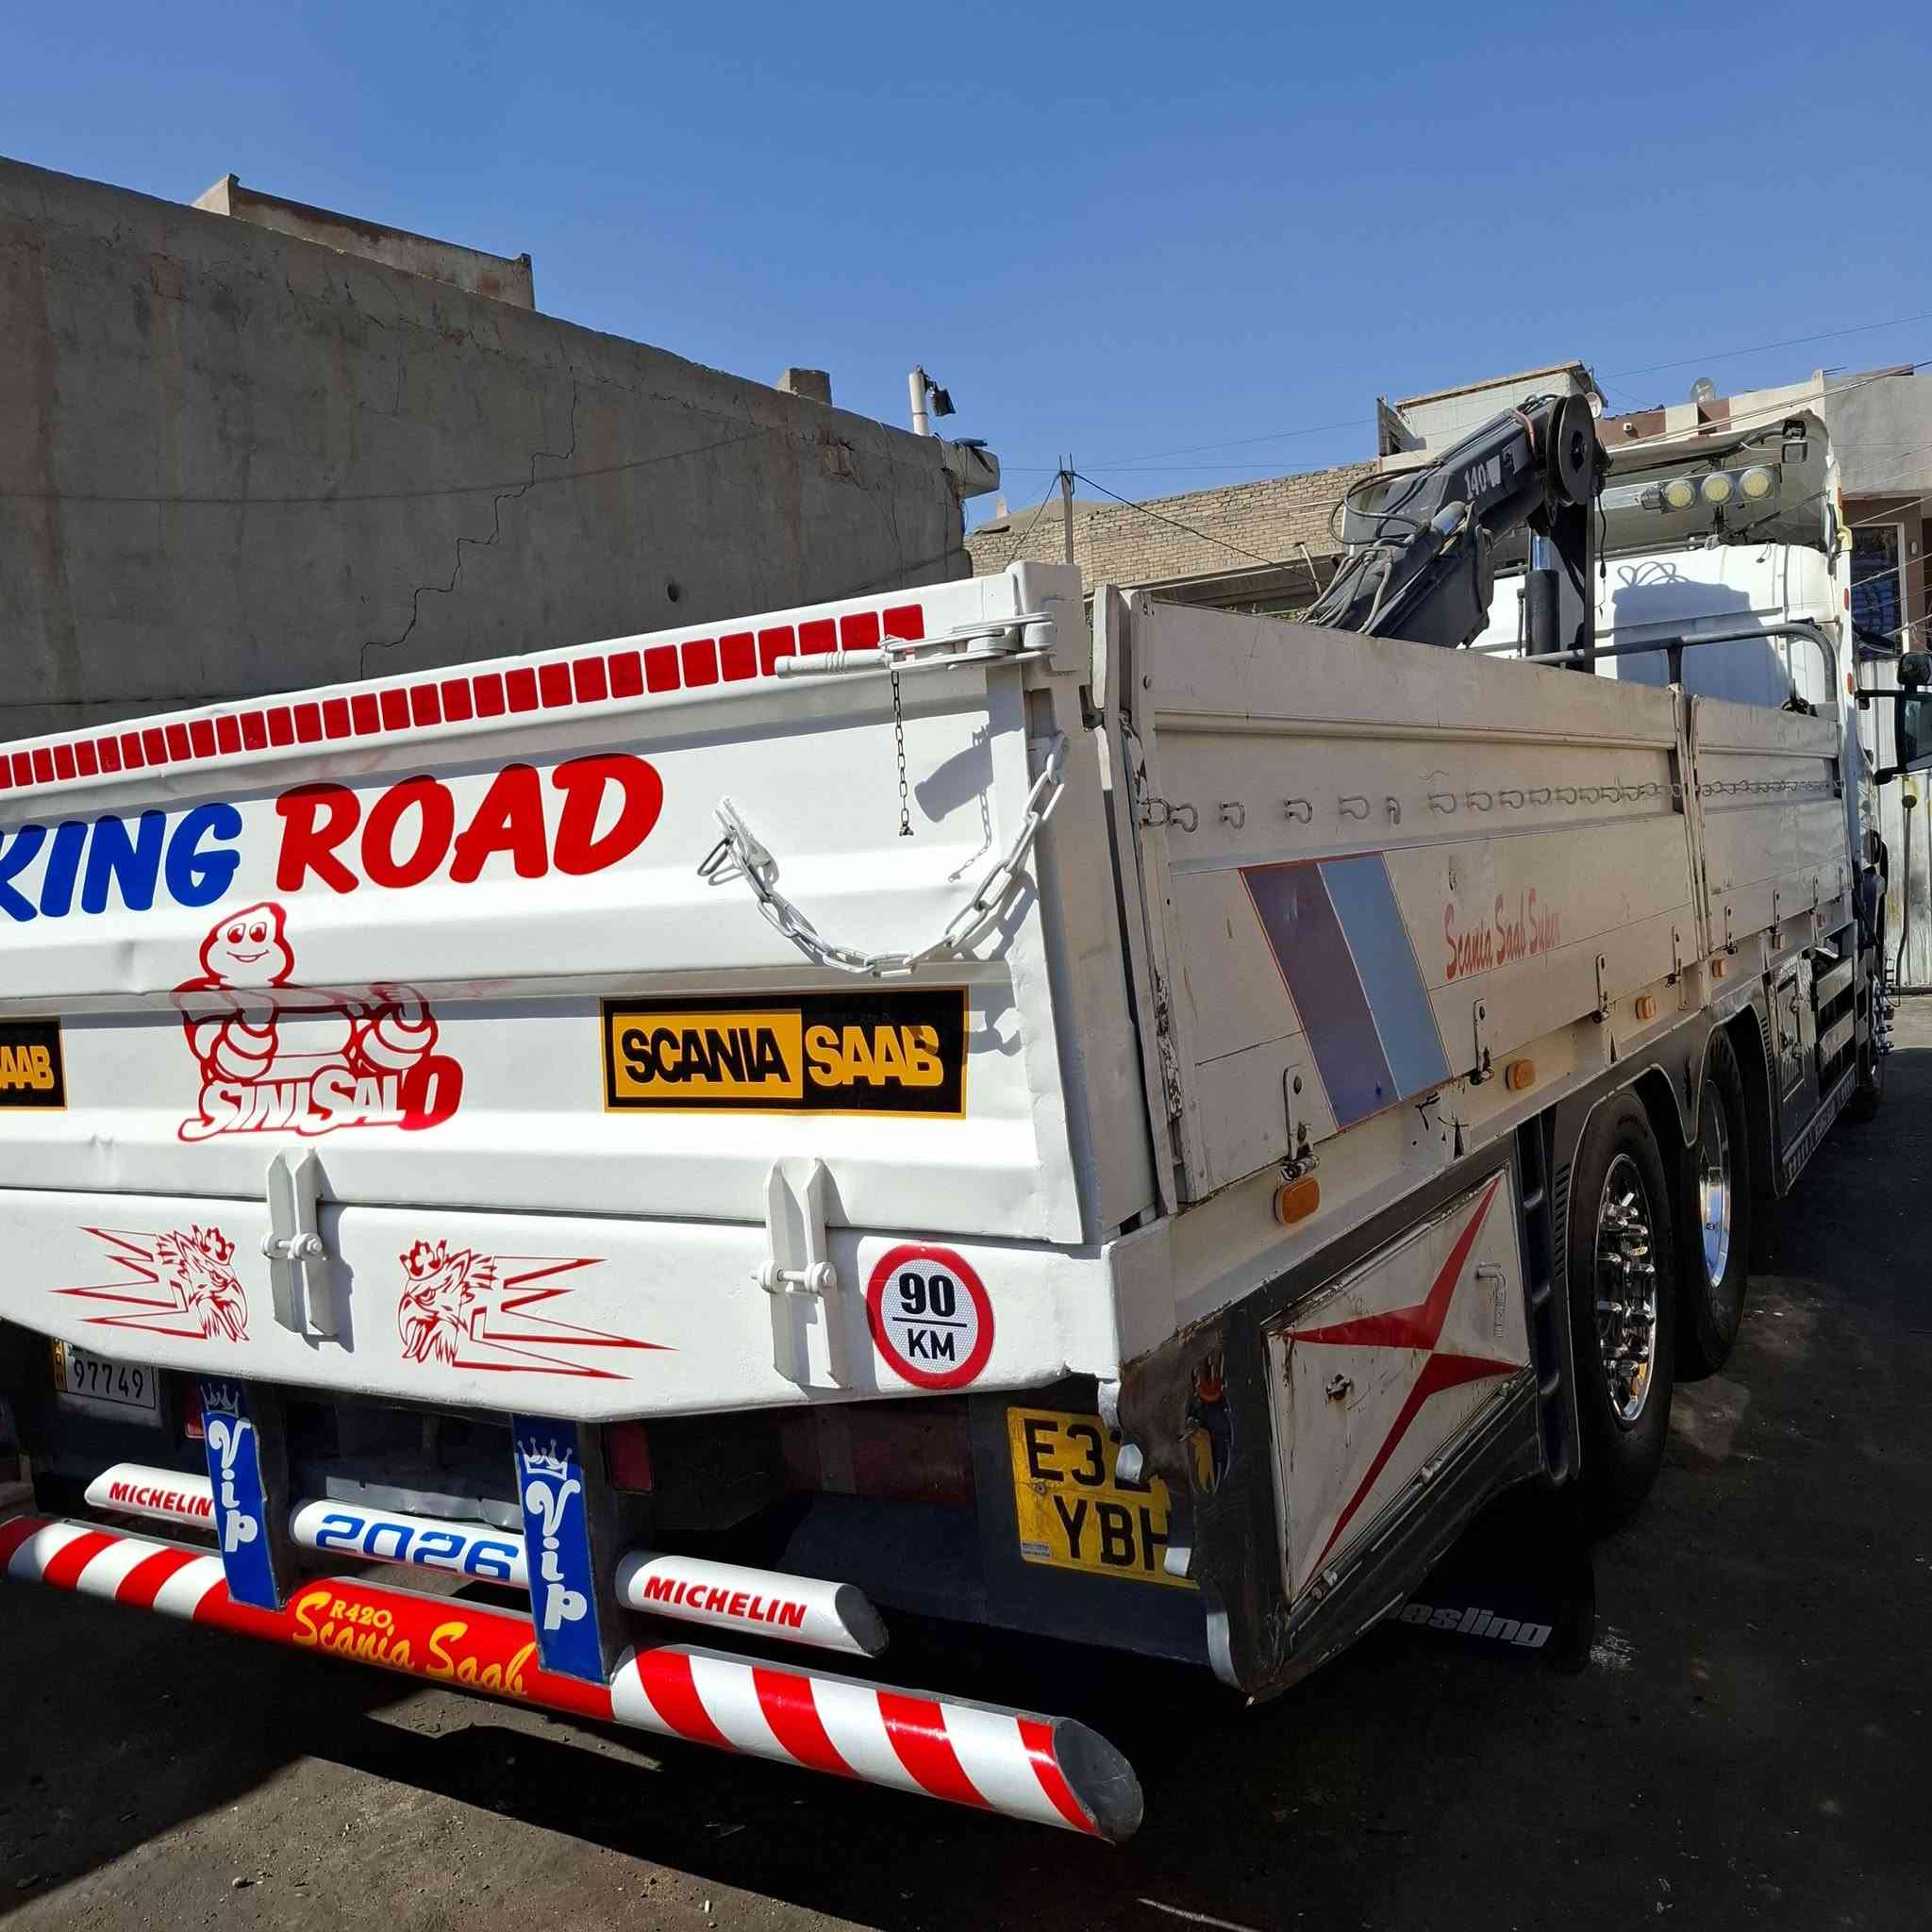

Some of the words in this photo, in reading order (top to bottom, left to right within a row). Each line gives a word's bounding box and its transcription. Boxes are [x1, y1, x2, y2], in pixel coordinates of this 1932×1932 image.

[0, 802, 242, 923] KING
[275, 753, 664, 894] ROAD
[0, 1045, 55, 1089] AAB
[620, 1026, 793, 1085] SCANIA
[805, 1024, 944, 1087] SAAB
[899, 1273, 956, 1318] 90
[908, 1328, 956, 1361] KM
[74, 1358, 143, 1399] 97749
[109, 1482, 214, 1517] MICHELIN
[316, 1513, 520, 1582] 2026
[330, 1598, 392, 1628] R420
[643, 1575, 808, 1629] MICHELIN
[292, 1591, 415, 1670] Scania
[426, 1621, 539, 1696] Saab
